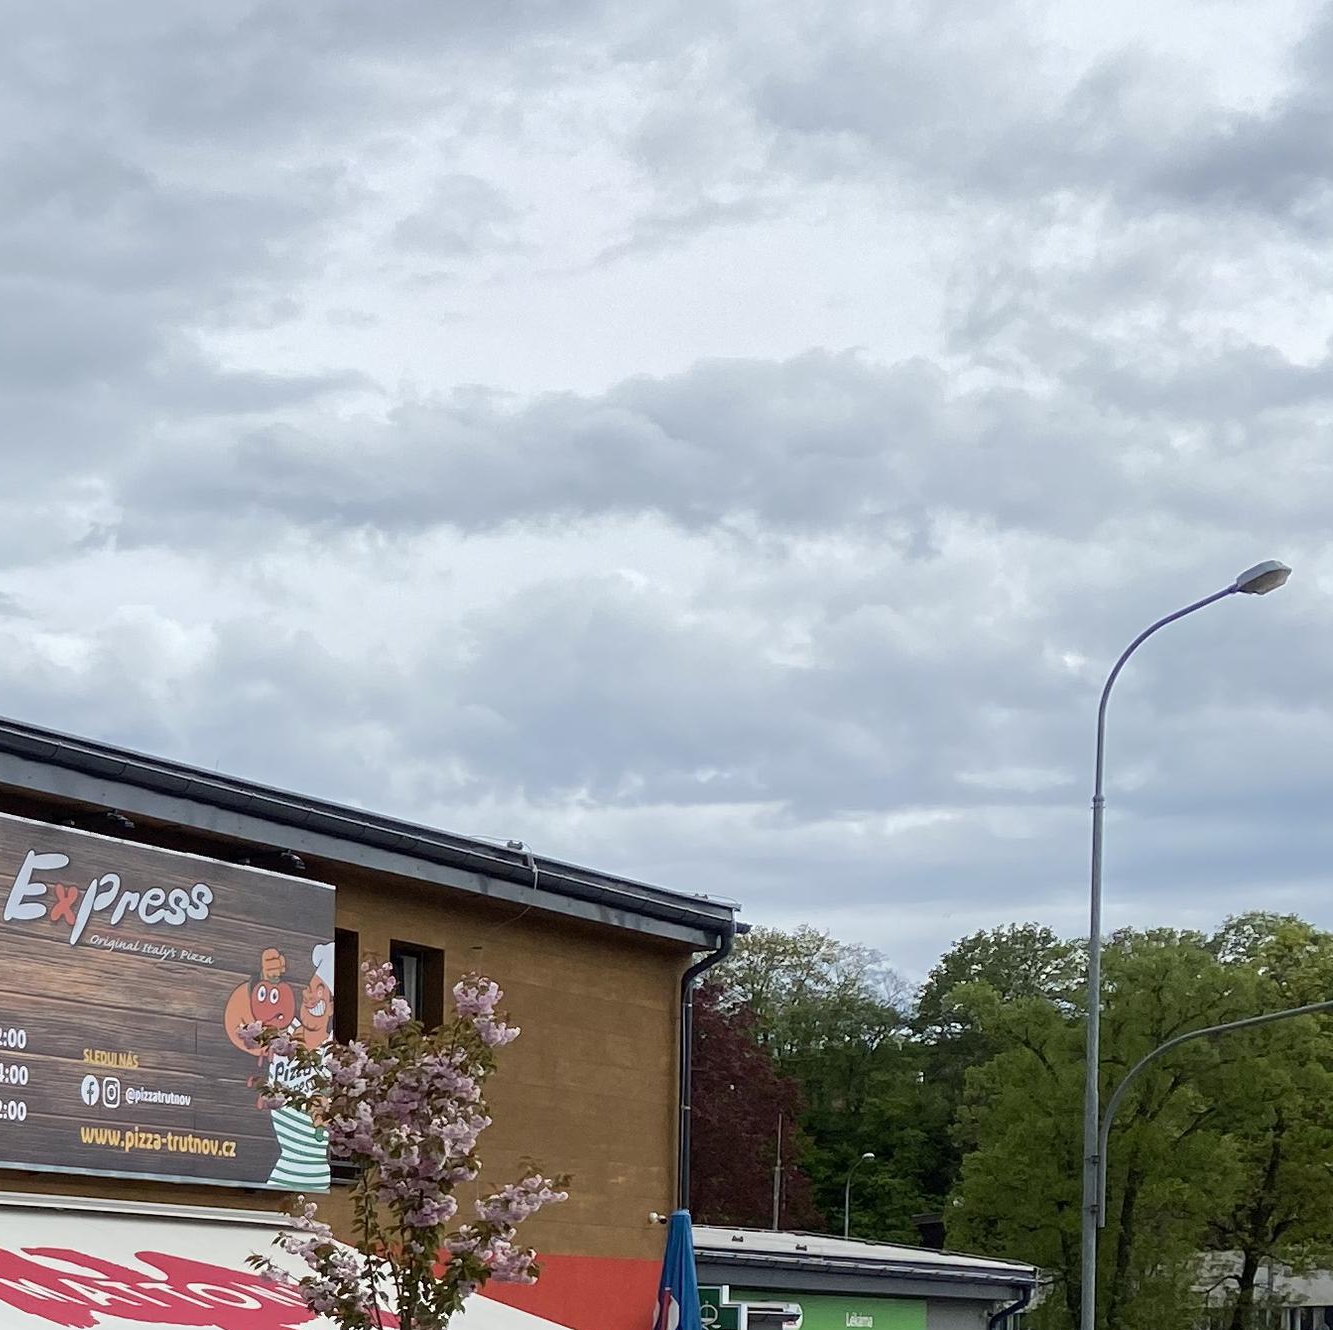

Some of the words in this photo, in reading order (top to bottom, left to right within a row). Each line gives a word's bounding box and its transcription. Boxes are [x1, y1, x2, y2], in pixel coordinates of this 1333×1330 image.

[4, 850, 214, 946] Express
[90, 934, 141, 952] Original
[141, 943, 177, 961] Italy's
[180, 950, 215, 965] Pizza
[83, 1048, 118, 1066] SLEDUJ
[119, 1051, 140, 1069] NÁS
[125, 1087, 192, 1106] @pizzatrutnov
[80, 1126, 237, 1158] www.pizza-trutnov.cz
